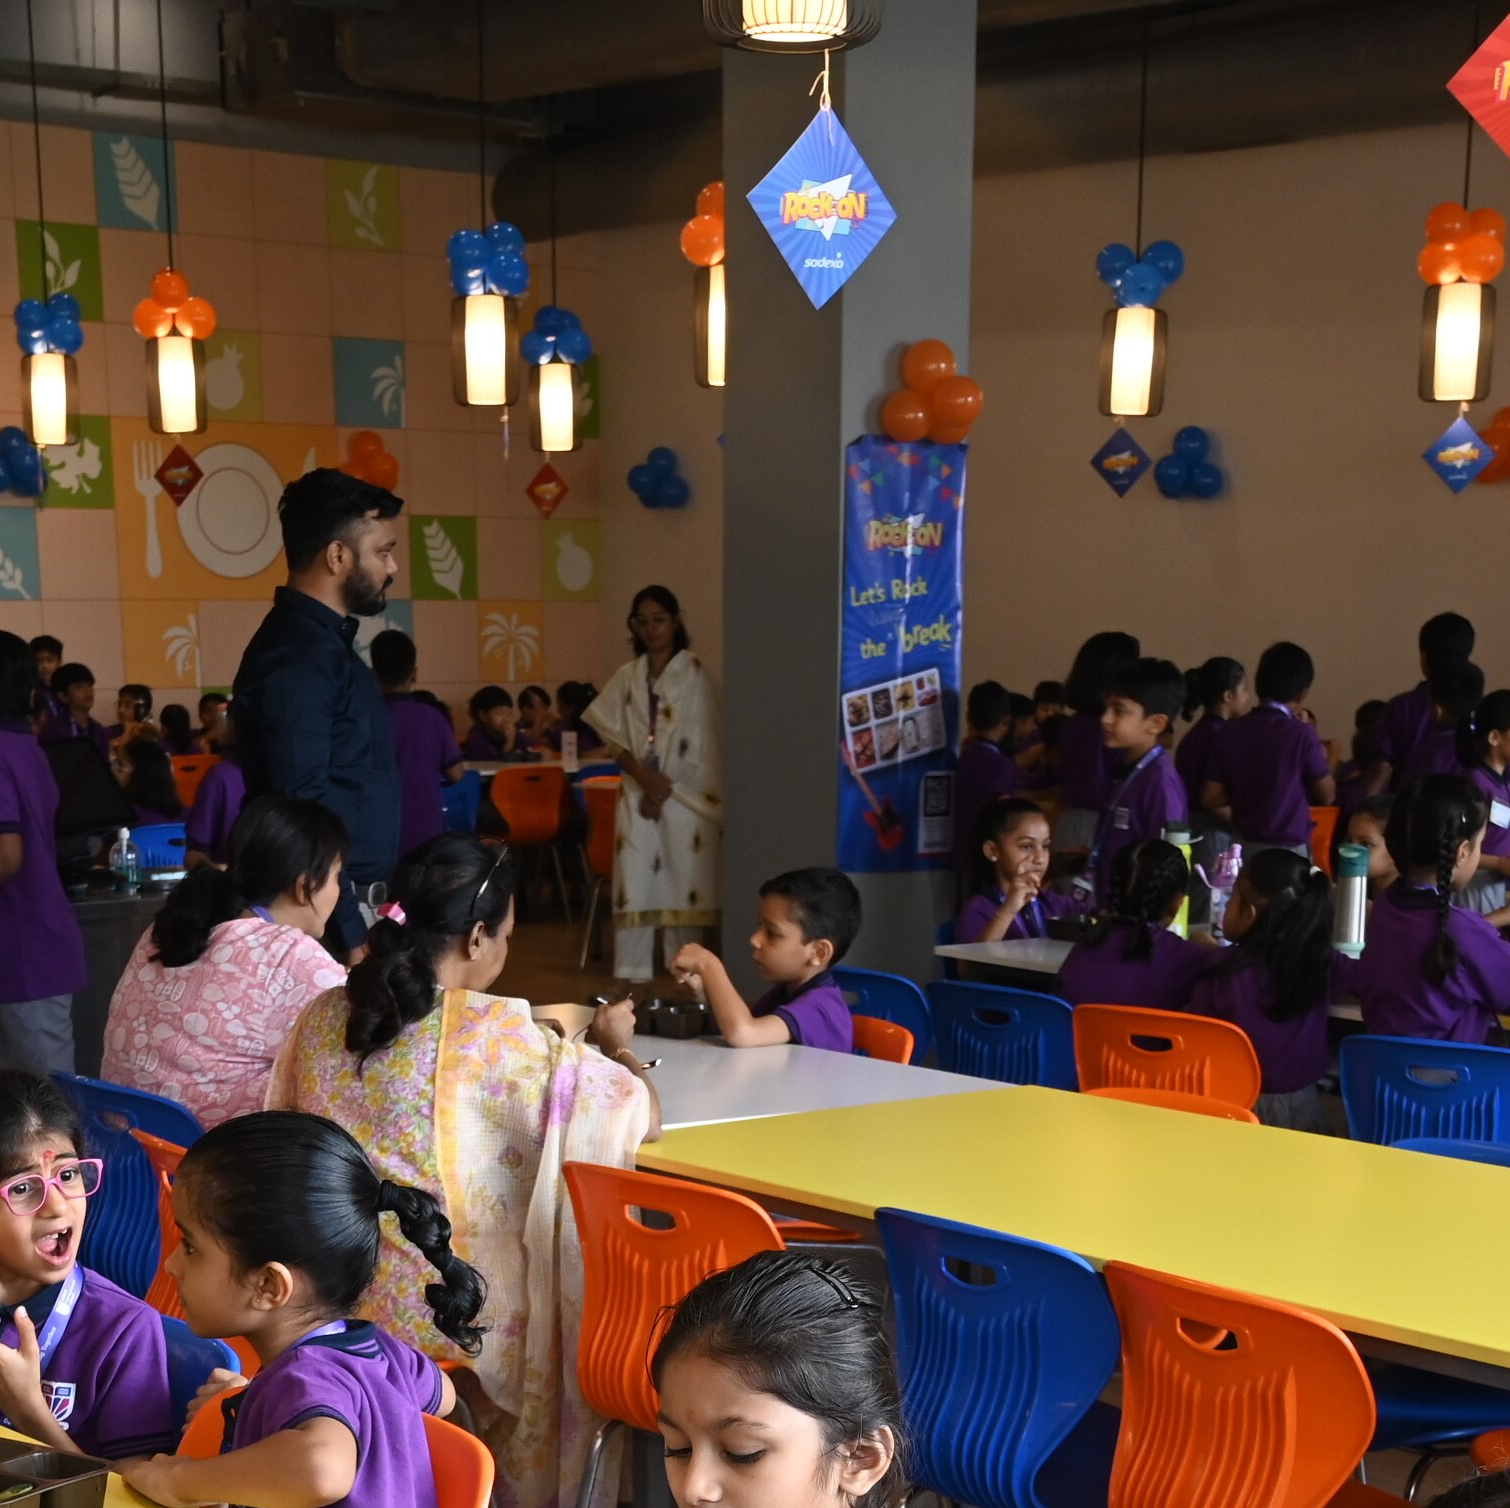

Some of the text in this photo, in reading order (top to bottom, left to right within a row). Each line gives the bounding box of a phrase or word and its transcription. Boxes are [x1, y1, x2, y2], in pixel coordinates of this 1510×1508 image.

[803, 252, 844, 269] sodexo
[850, 575, 928, 608] Let's Rock
[859, 614, 953, 660] the break
